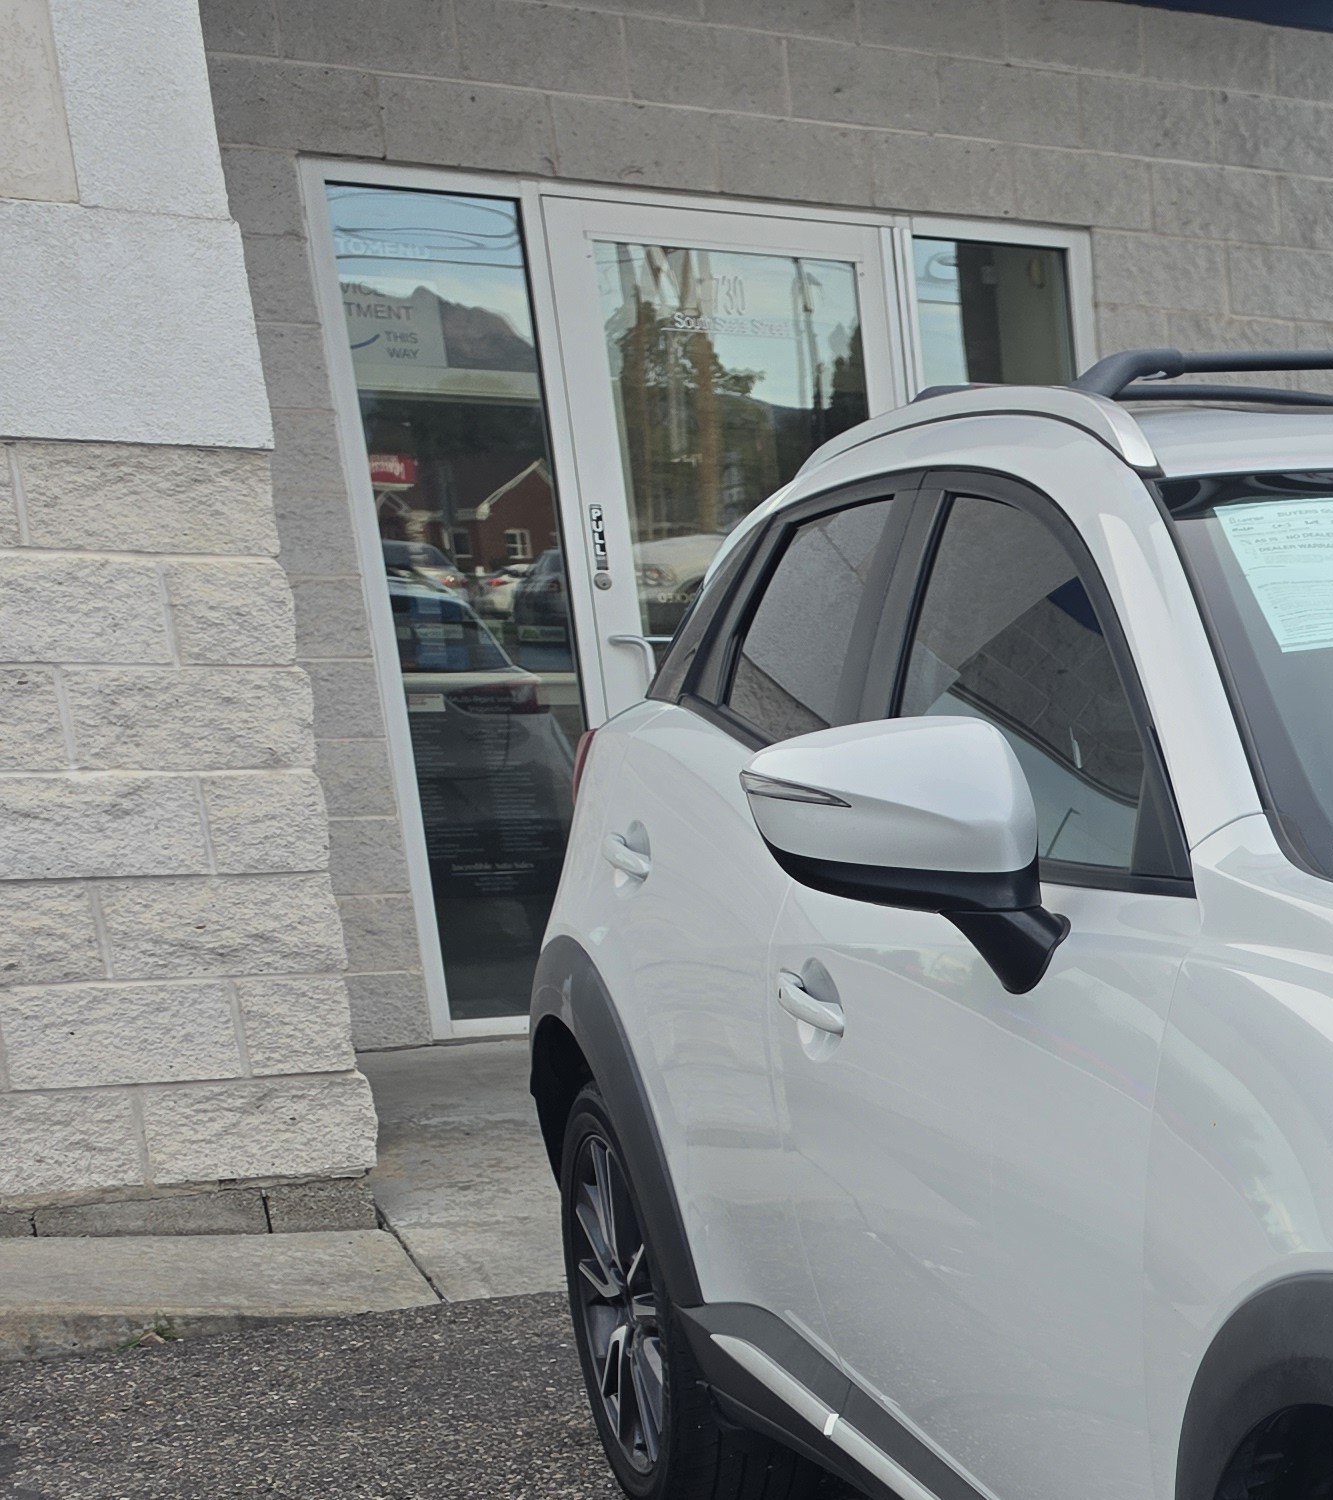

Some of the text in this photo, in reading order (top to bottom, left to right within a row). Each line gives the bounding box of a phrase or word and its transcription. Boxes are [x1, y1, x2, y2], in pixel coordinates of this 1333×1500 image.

[343, 301, 414, 321] TMENT
[384, 330, 419, 344] THIS
[385, 347, 420, 360] WAY
[1277, 508, 1318, 518] BUYERS
[591, 508, 606, 556] PULL
[1254, 537, 1268, 545] AS
[1286, 533, 1301, 541] NO
[1258, 544, 1297, 553] DEALER
